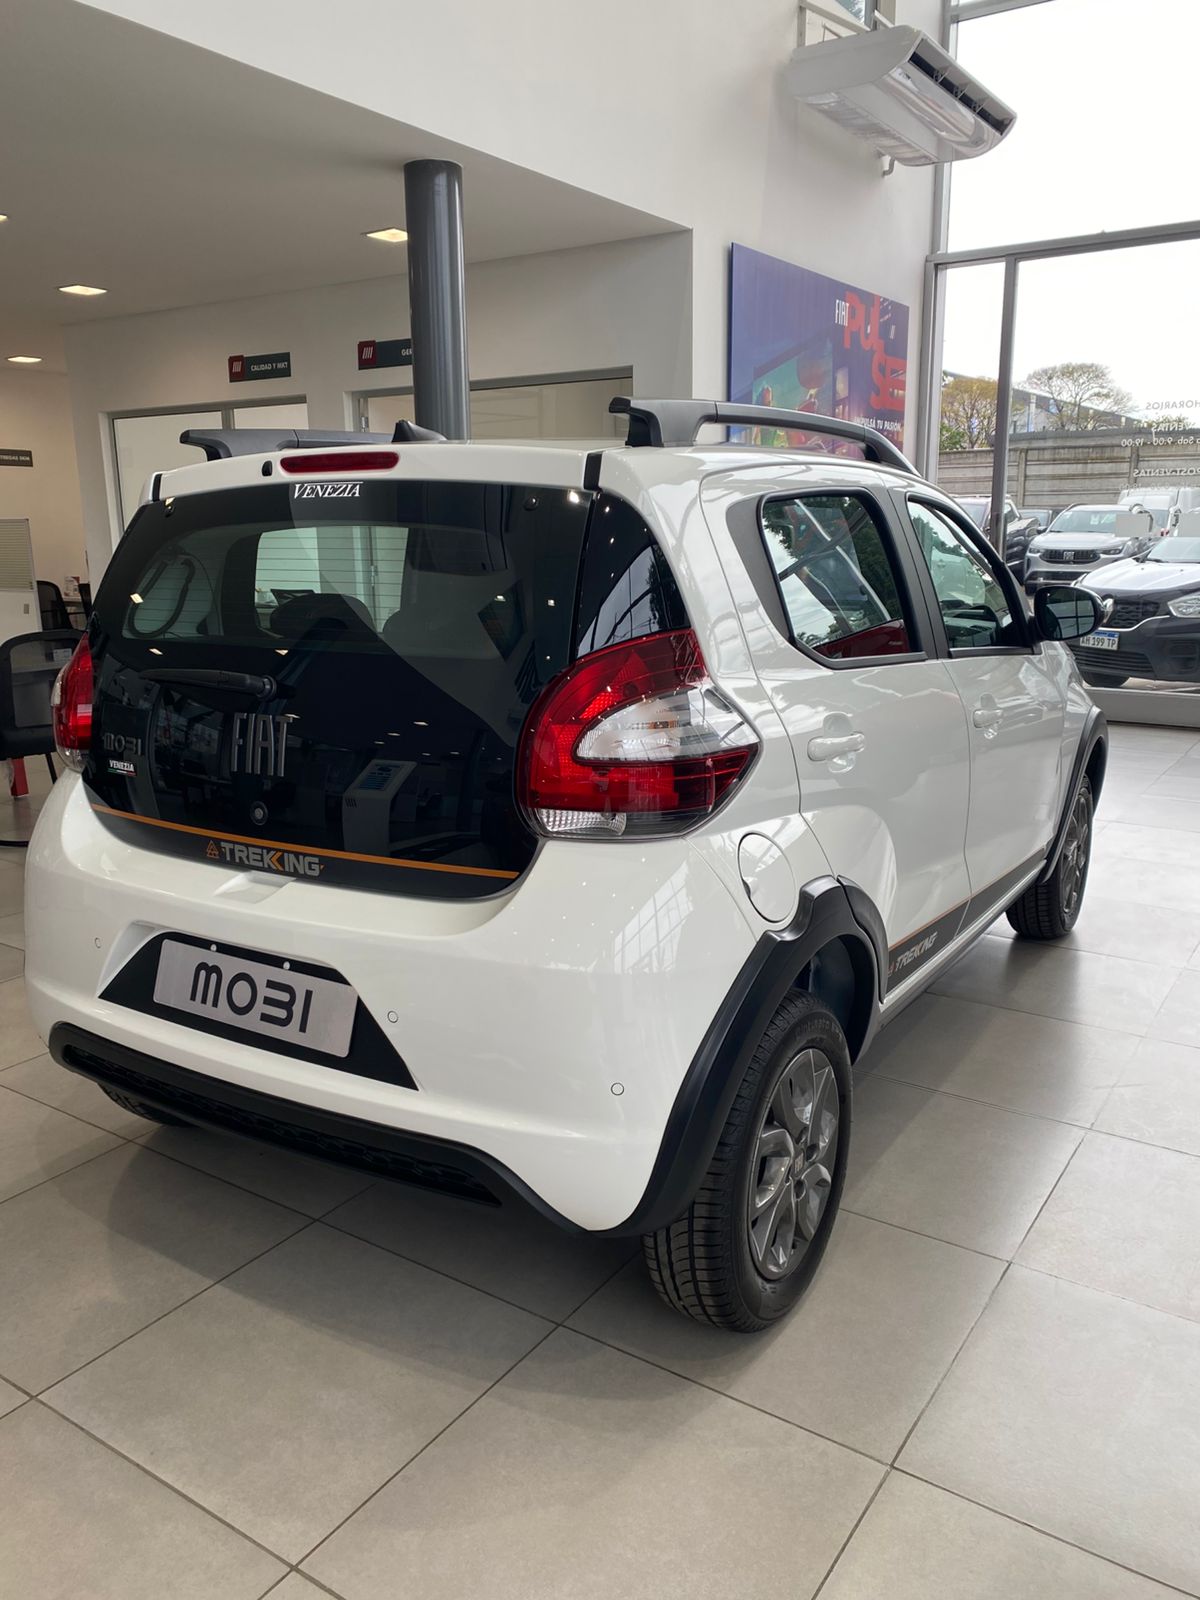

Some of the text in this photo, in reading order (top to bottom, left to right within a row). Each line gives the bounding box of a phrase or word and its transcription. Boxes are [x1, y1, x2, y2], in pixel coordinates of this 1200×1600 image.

[835, 300, 850, 327] FIAT
[251, 363, 272, 371] CALIDAD
[877, 420, 883, 429] TU
[294, 483, 361, 499] VENEZIA
[1107, 638, 1116, 648] TP
[103, 732, 142, 756] MOBI
[231, 712, 293, 777] FIAT
[109, 759, 135, 772] VENEZIA
[221, 842, 320, 876] TREKKING
[190, 962, 313, 1034] MOBI
